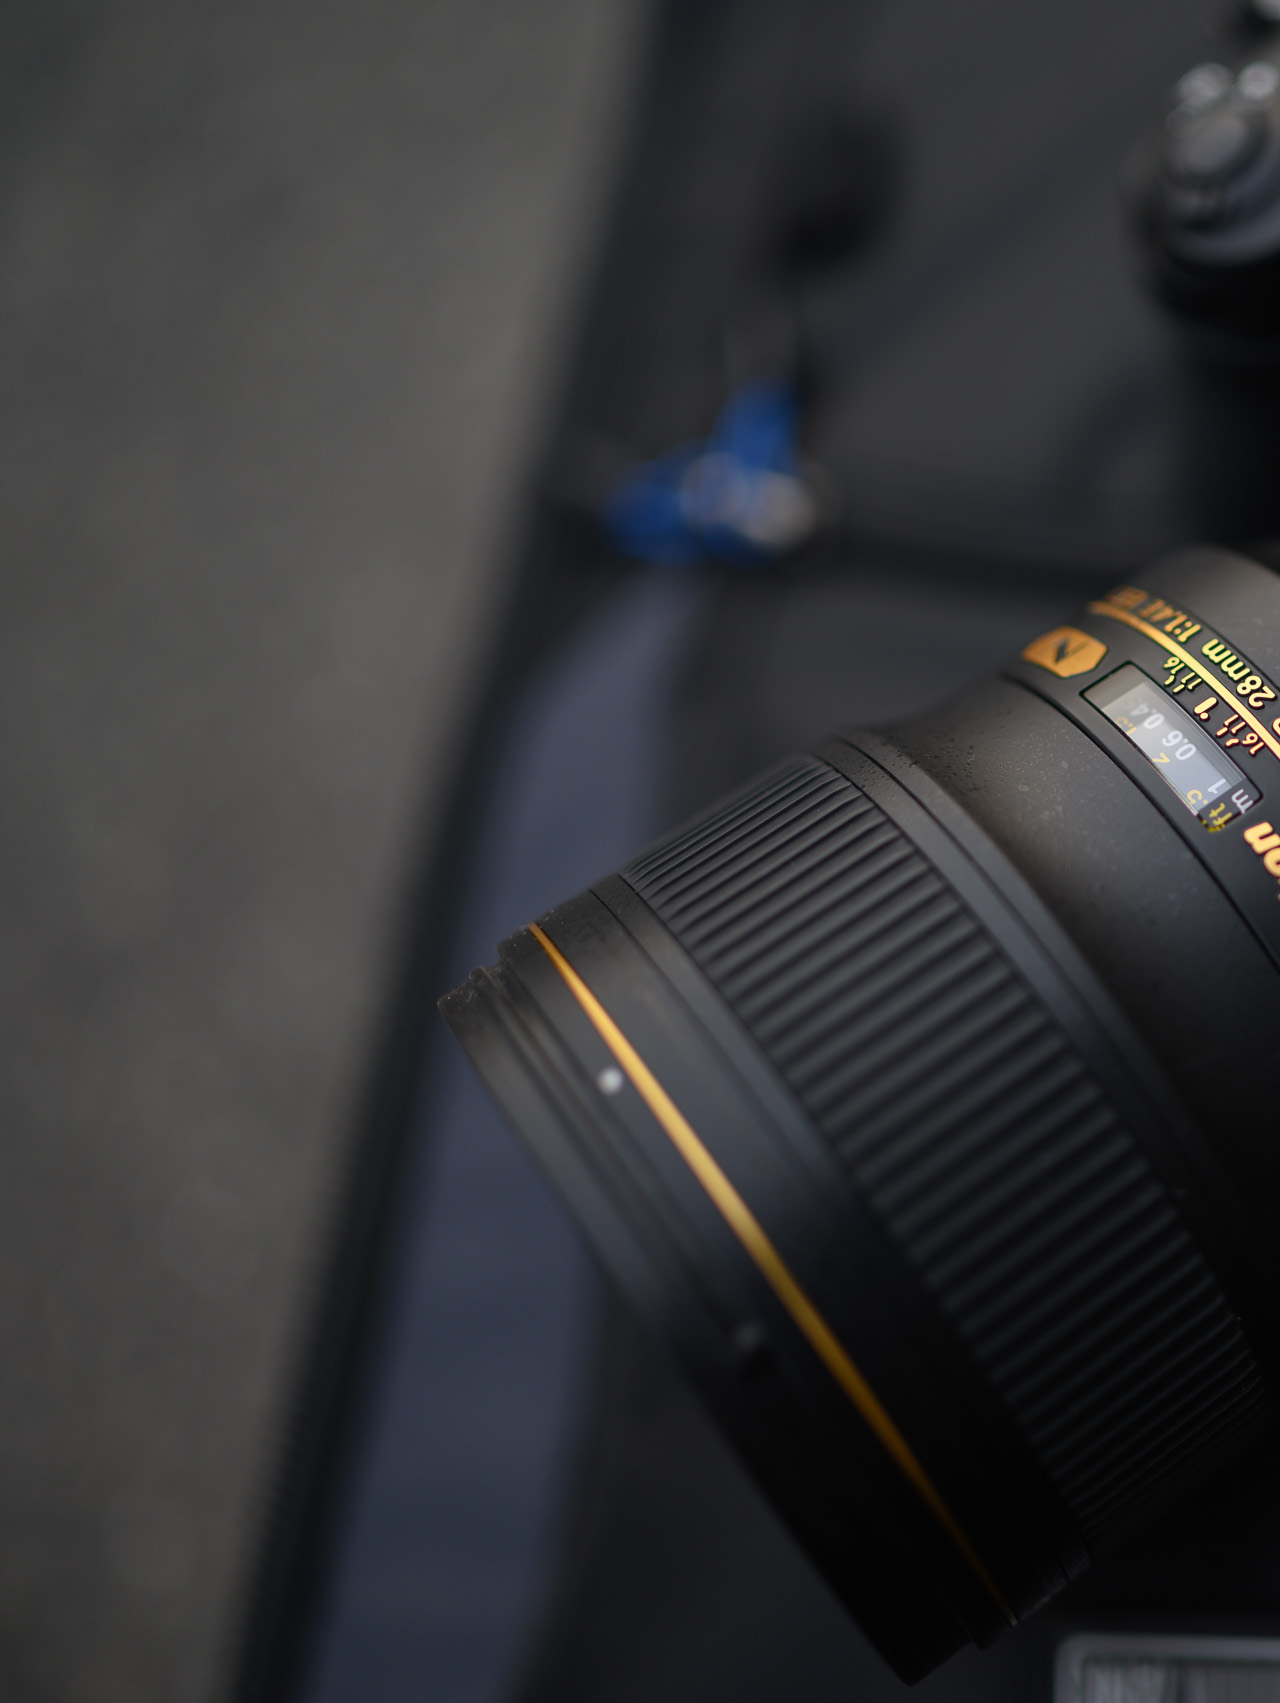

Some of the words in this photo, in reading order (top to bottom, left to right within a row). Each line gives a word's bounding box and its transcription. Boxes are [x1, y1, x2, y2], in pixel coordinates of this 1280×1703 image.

[1163, 656, 1186, 675] 16
[1201, 638, 1278, 709] 28mm
[1181, 671, 1202, 692] 11
[1130, 702, 1165, 729] 0.4
[1224, 714, 1247, 735] 11
[1161, 730, 1197, 760] 0.6
[1241, 732, 1266, 757] 16
[1208, 802, 1233, 825] ft
[1231, 788, 1254, 814] m
